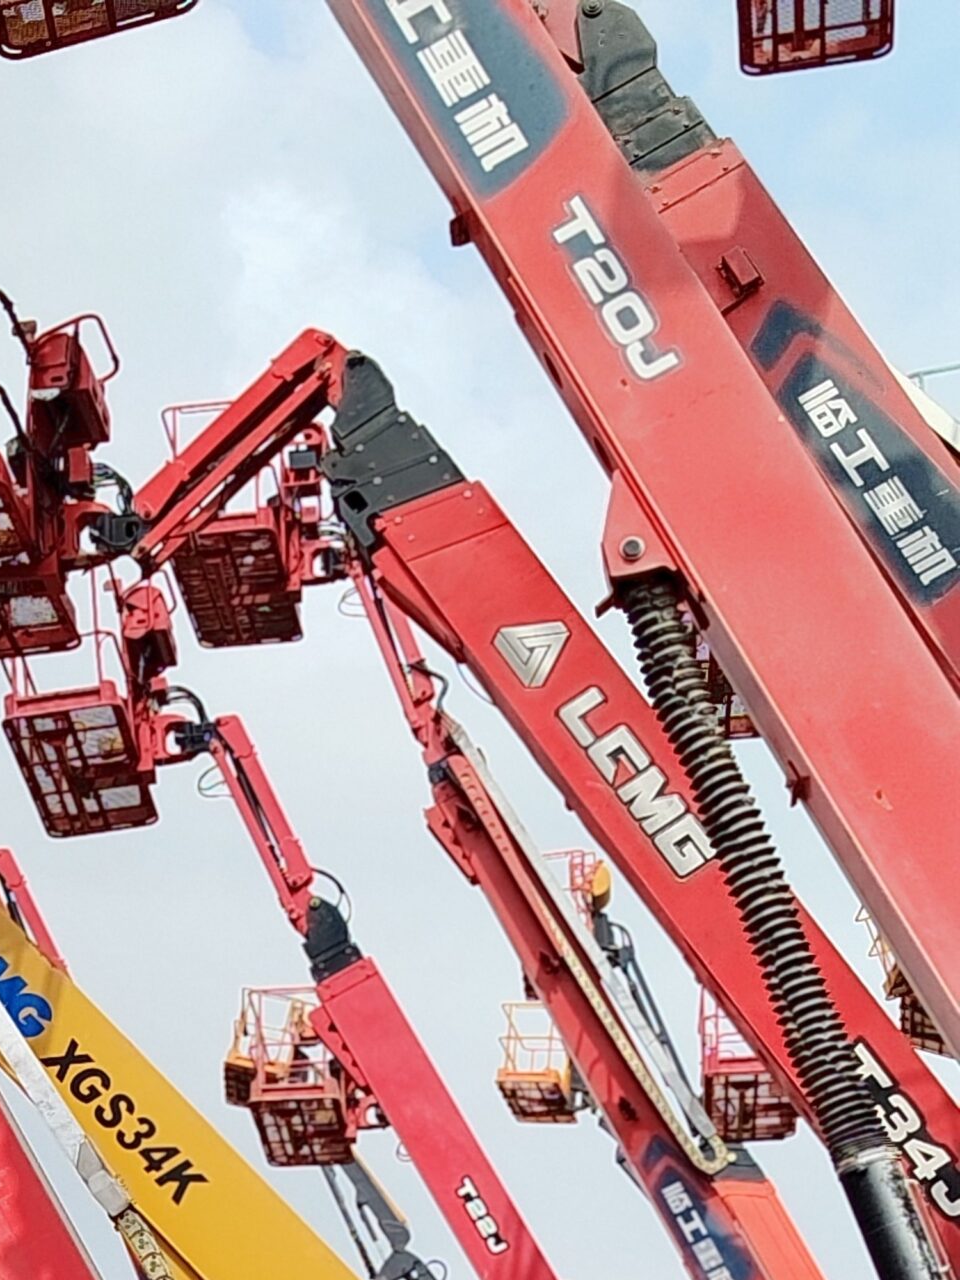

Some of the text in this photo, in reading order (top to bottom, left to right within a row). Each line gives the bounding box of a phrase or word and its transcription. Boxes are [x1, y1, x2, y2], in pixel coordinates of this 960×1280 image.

[552, 194, 680, 380] T20J
[797, 378, 958, 587] 临工重机
[557, 685, 718, 878] LGMG
[40, 1038, 211, 1206] XGS34K
